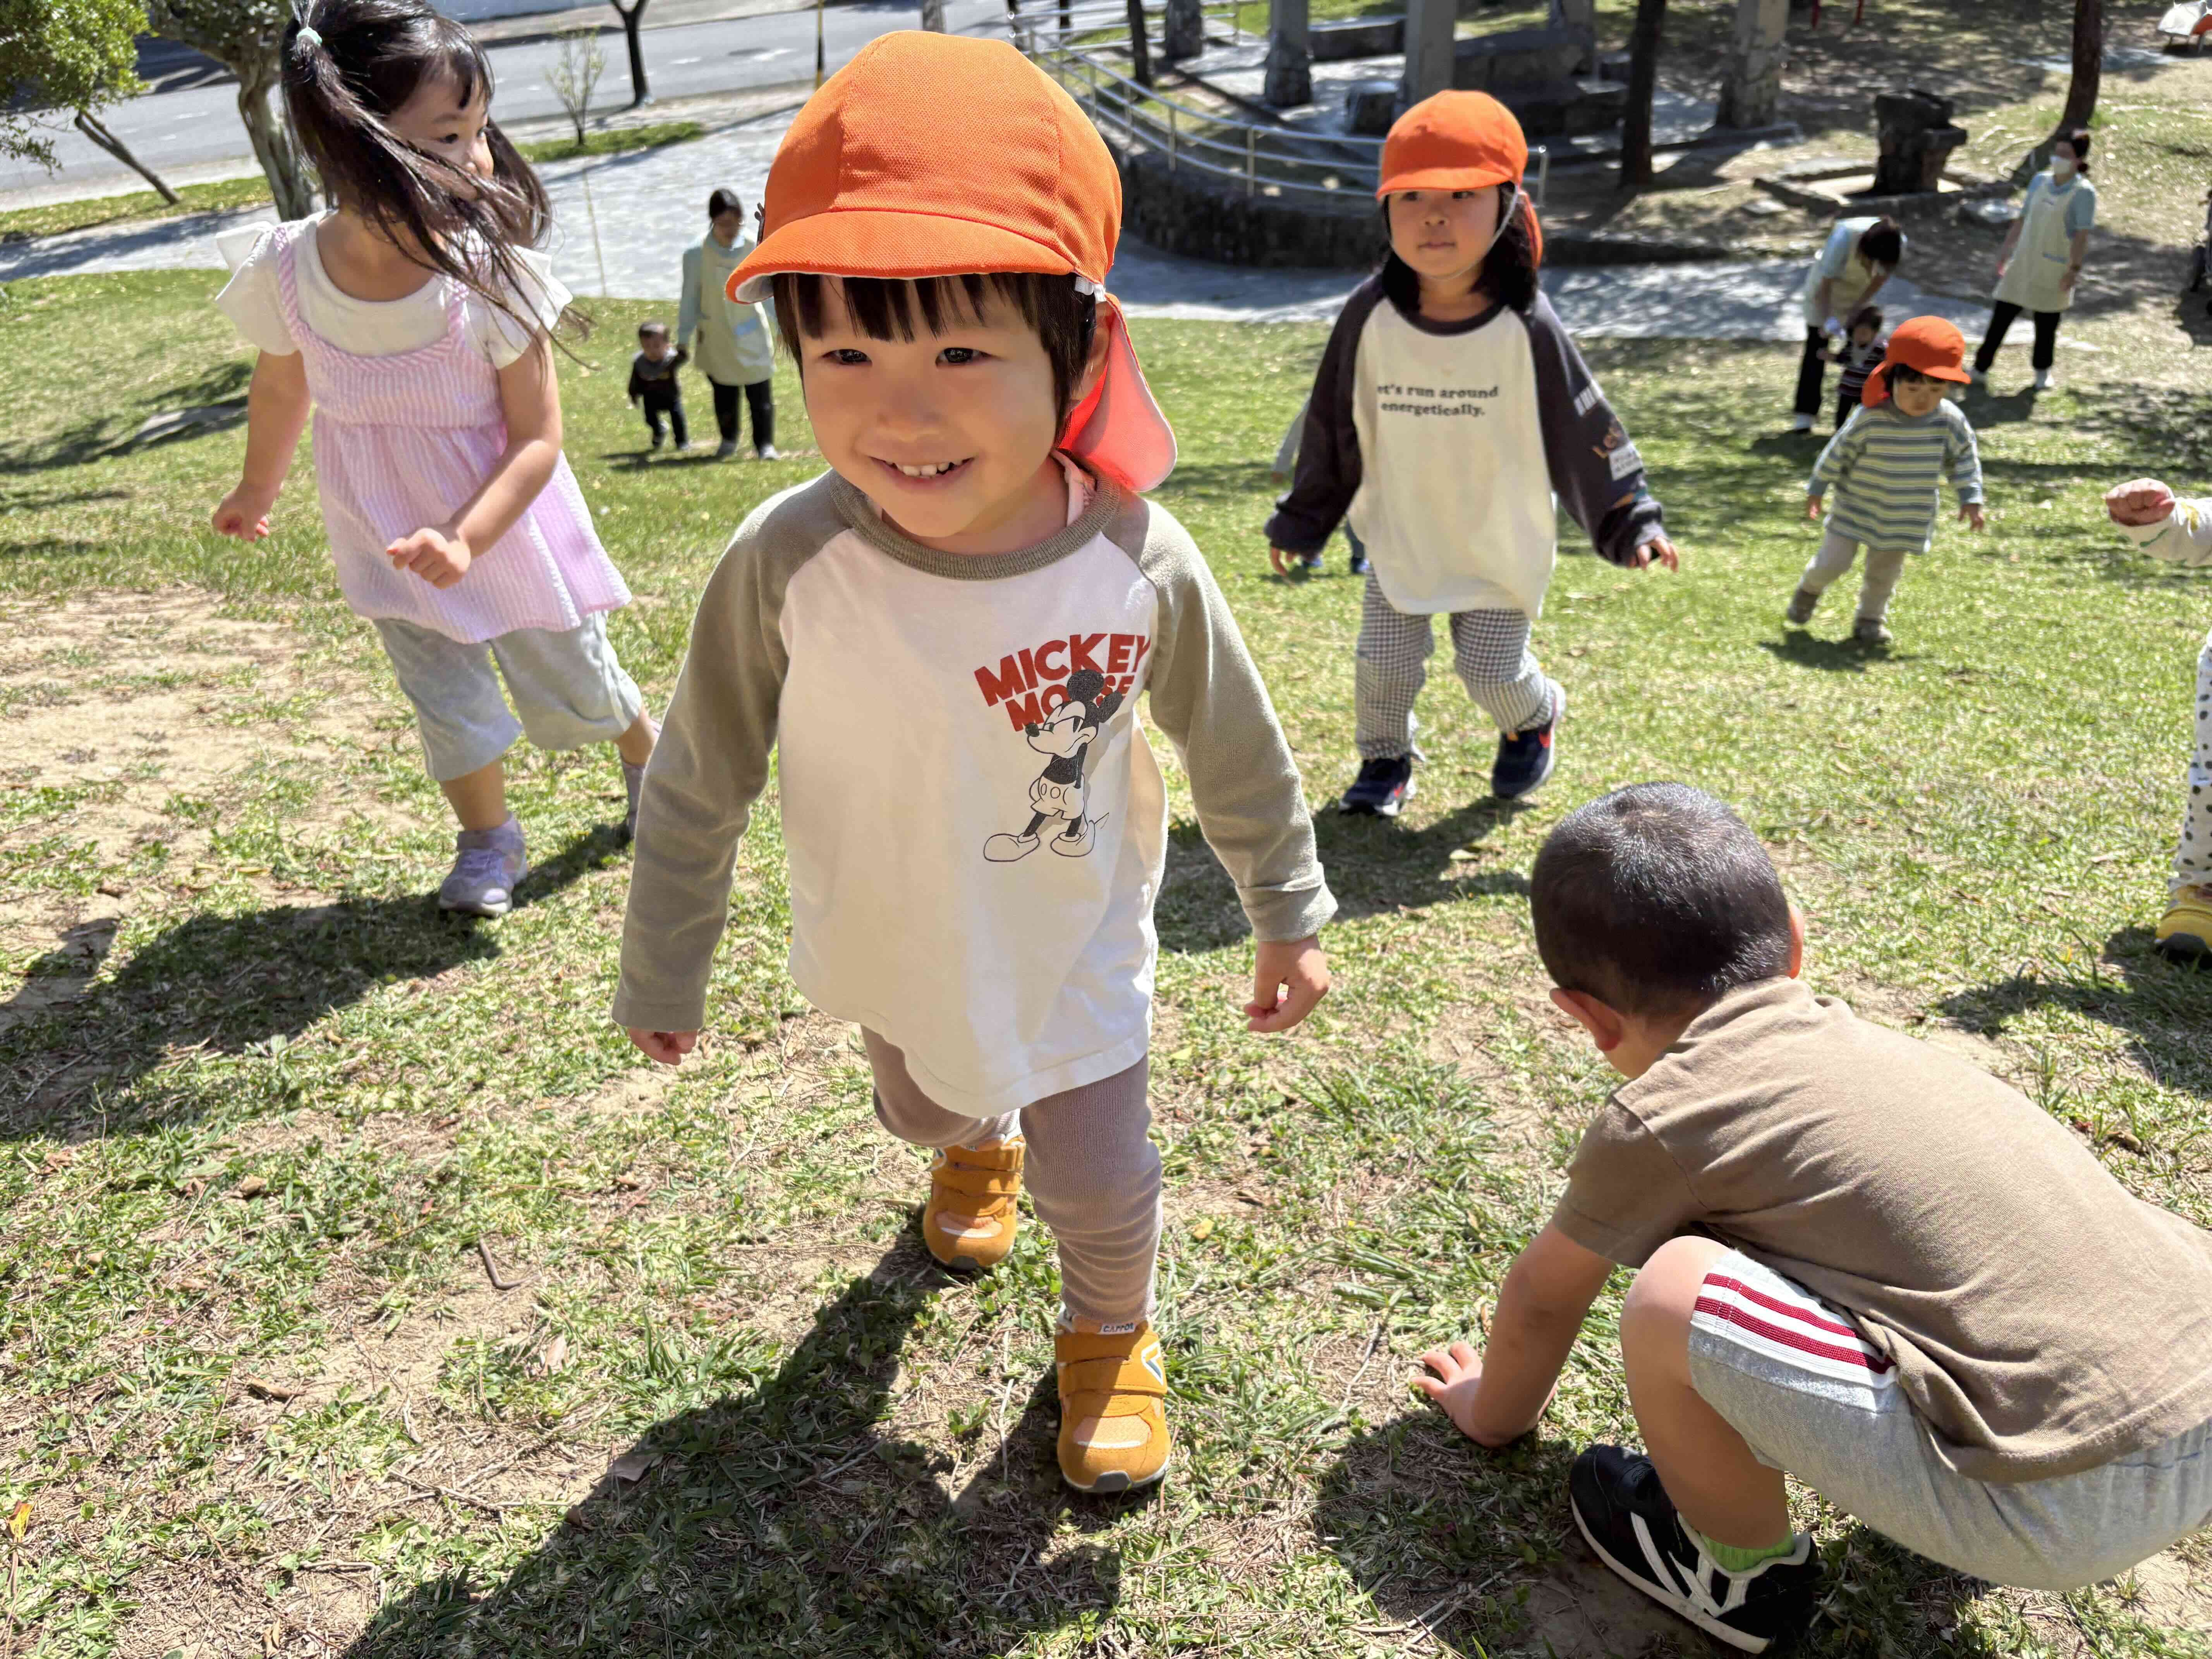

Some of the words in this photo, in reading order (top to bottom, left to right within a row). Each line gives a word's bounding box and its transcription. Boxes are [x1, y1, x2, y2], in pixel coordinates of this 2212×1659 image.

[1377, 383, 1402, 395] et's
[1407, 386, 1434, 397] run
[1439, 385, 1498, 398] around
[1381, 403, 1485, 417] energetically.
[974, 633, 1151, 707] MICKEY
[1005, 675, 1135, 732] MOSE
